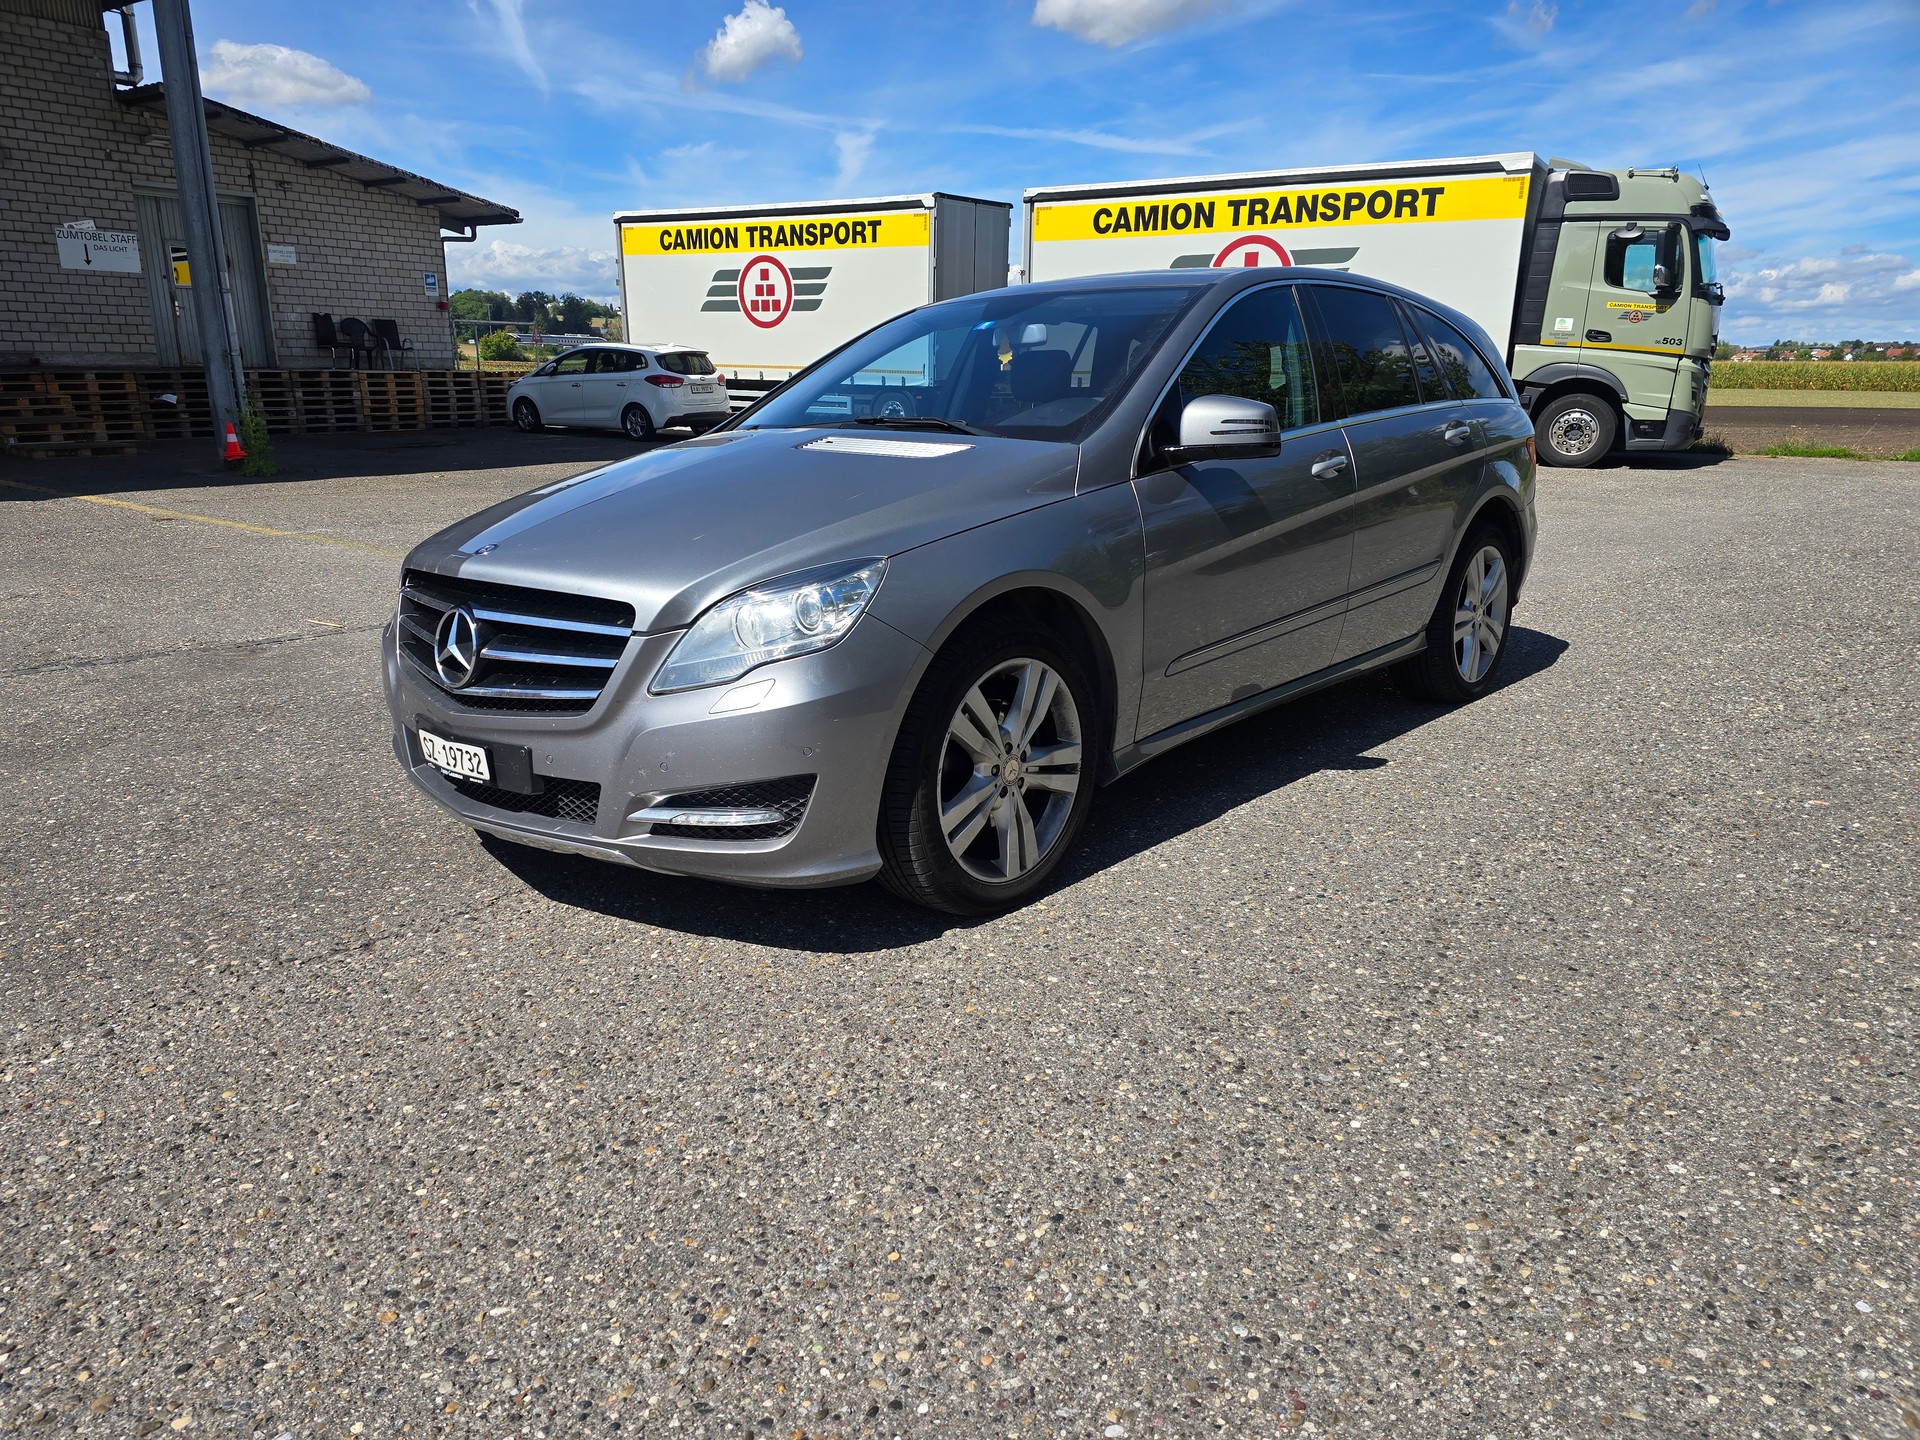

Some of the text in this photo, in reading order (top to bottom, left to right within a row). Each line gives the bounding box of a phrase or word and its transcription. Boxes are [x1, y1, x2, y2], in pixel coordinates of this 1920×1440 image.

[1093, 187, 1445, 234] CAMION TRANSPORT
[56, 229, 137, 244] ZUMTOBEL STAFF
[659, 219, 882, 250] CAMION TRANSPORT
[93, 244, 128, 253] DAS LICHT
